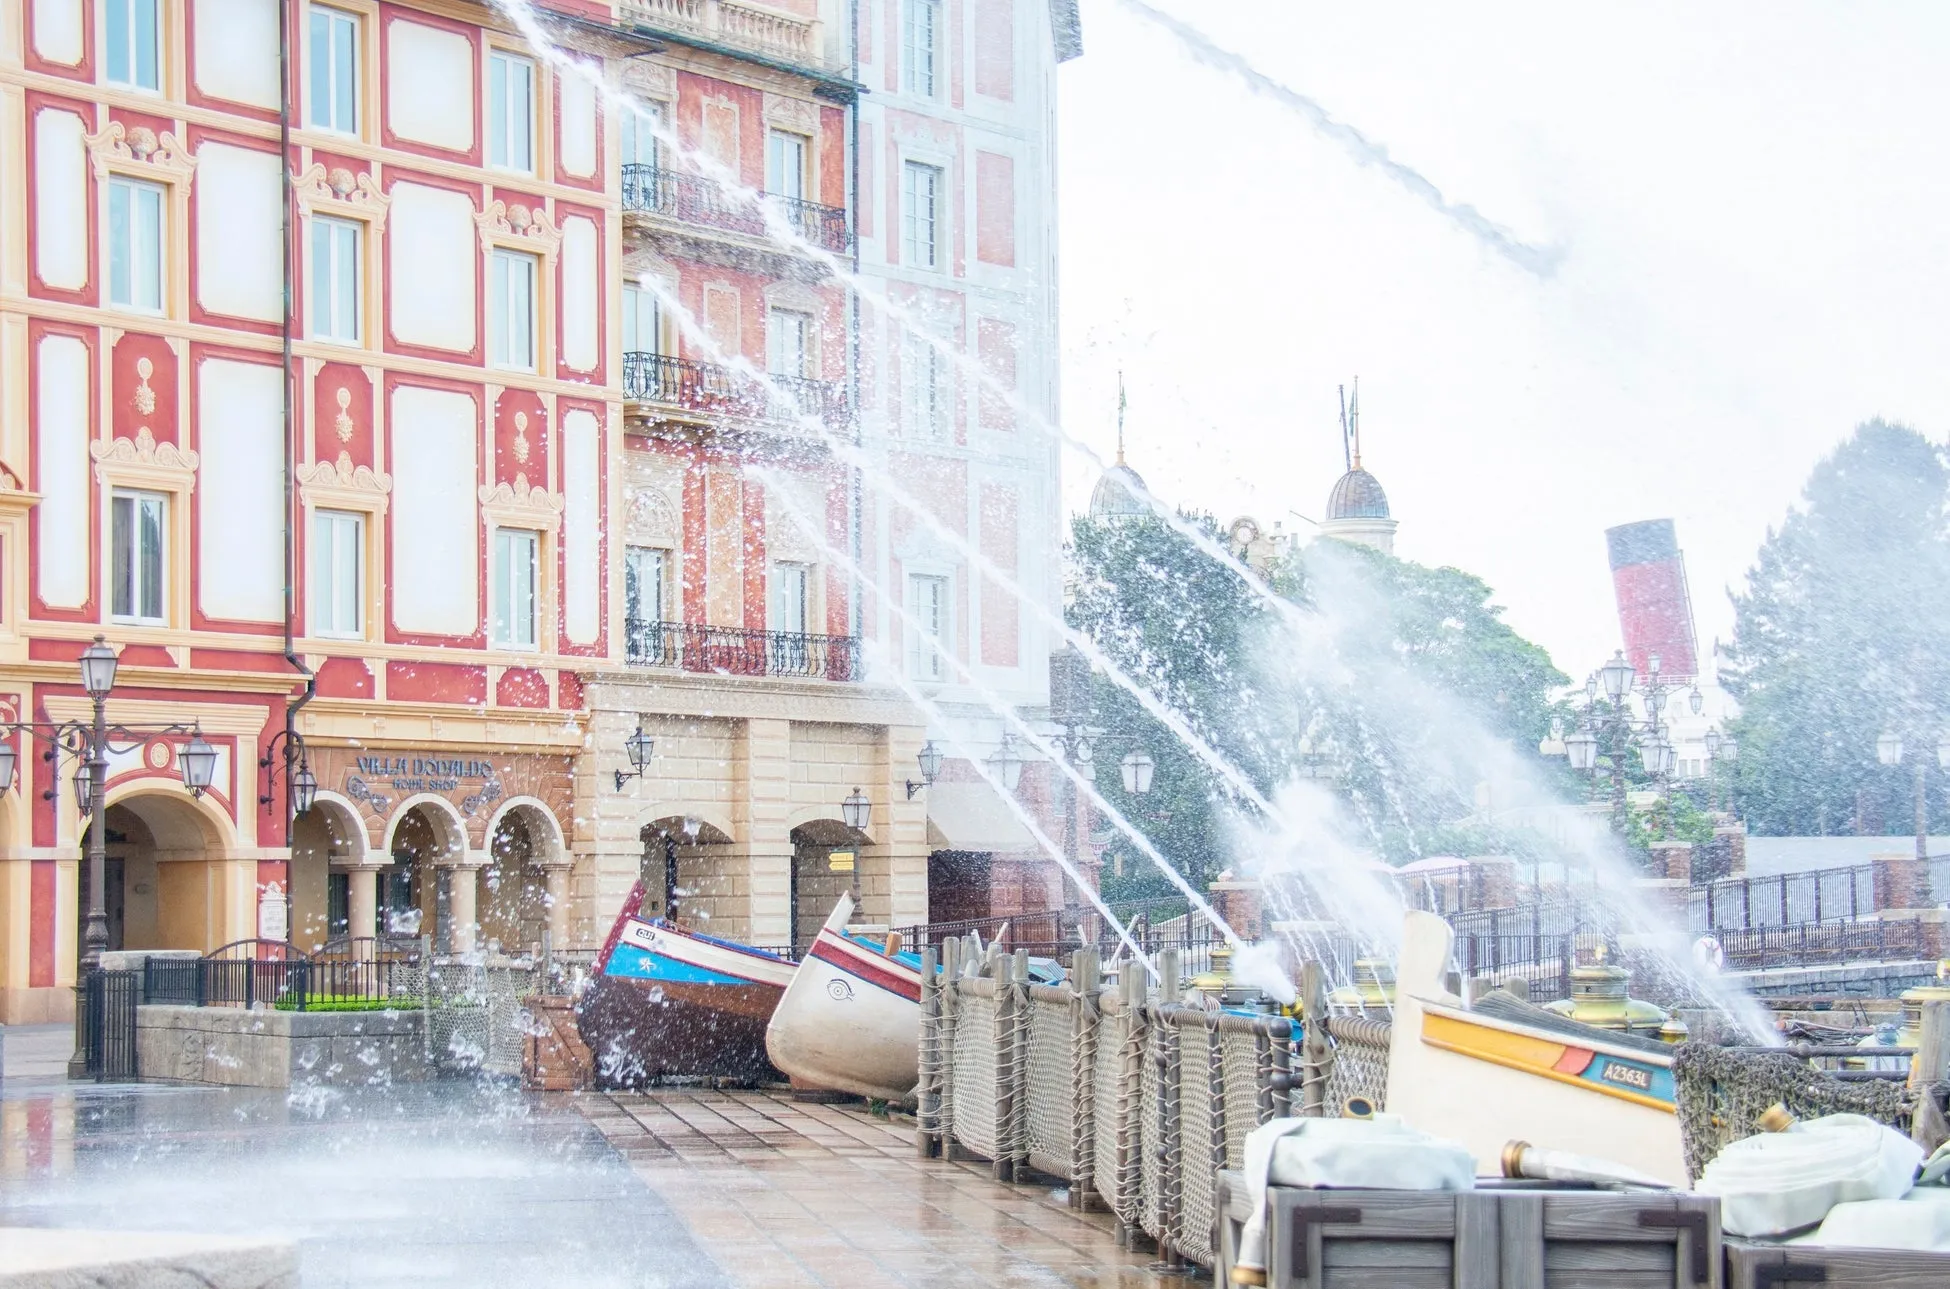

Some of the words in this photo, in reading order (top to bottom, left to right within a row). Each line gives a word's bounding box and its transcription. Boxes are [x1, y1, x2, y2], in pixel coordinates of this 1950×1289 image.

[357, 756, 409, 776] VILLA
[429, 779, 459, 791] SHOP
[1603, 1062, 1647, 1087] A2363L
